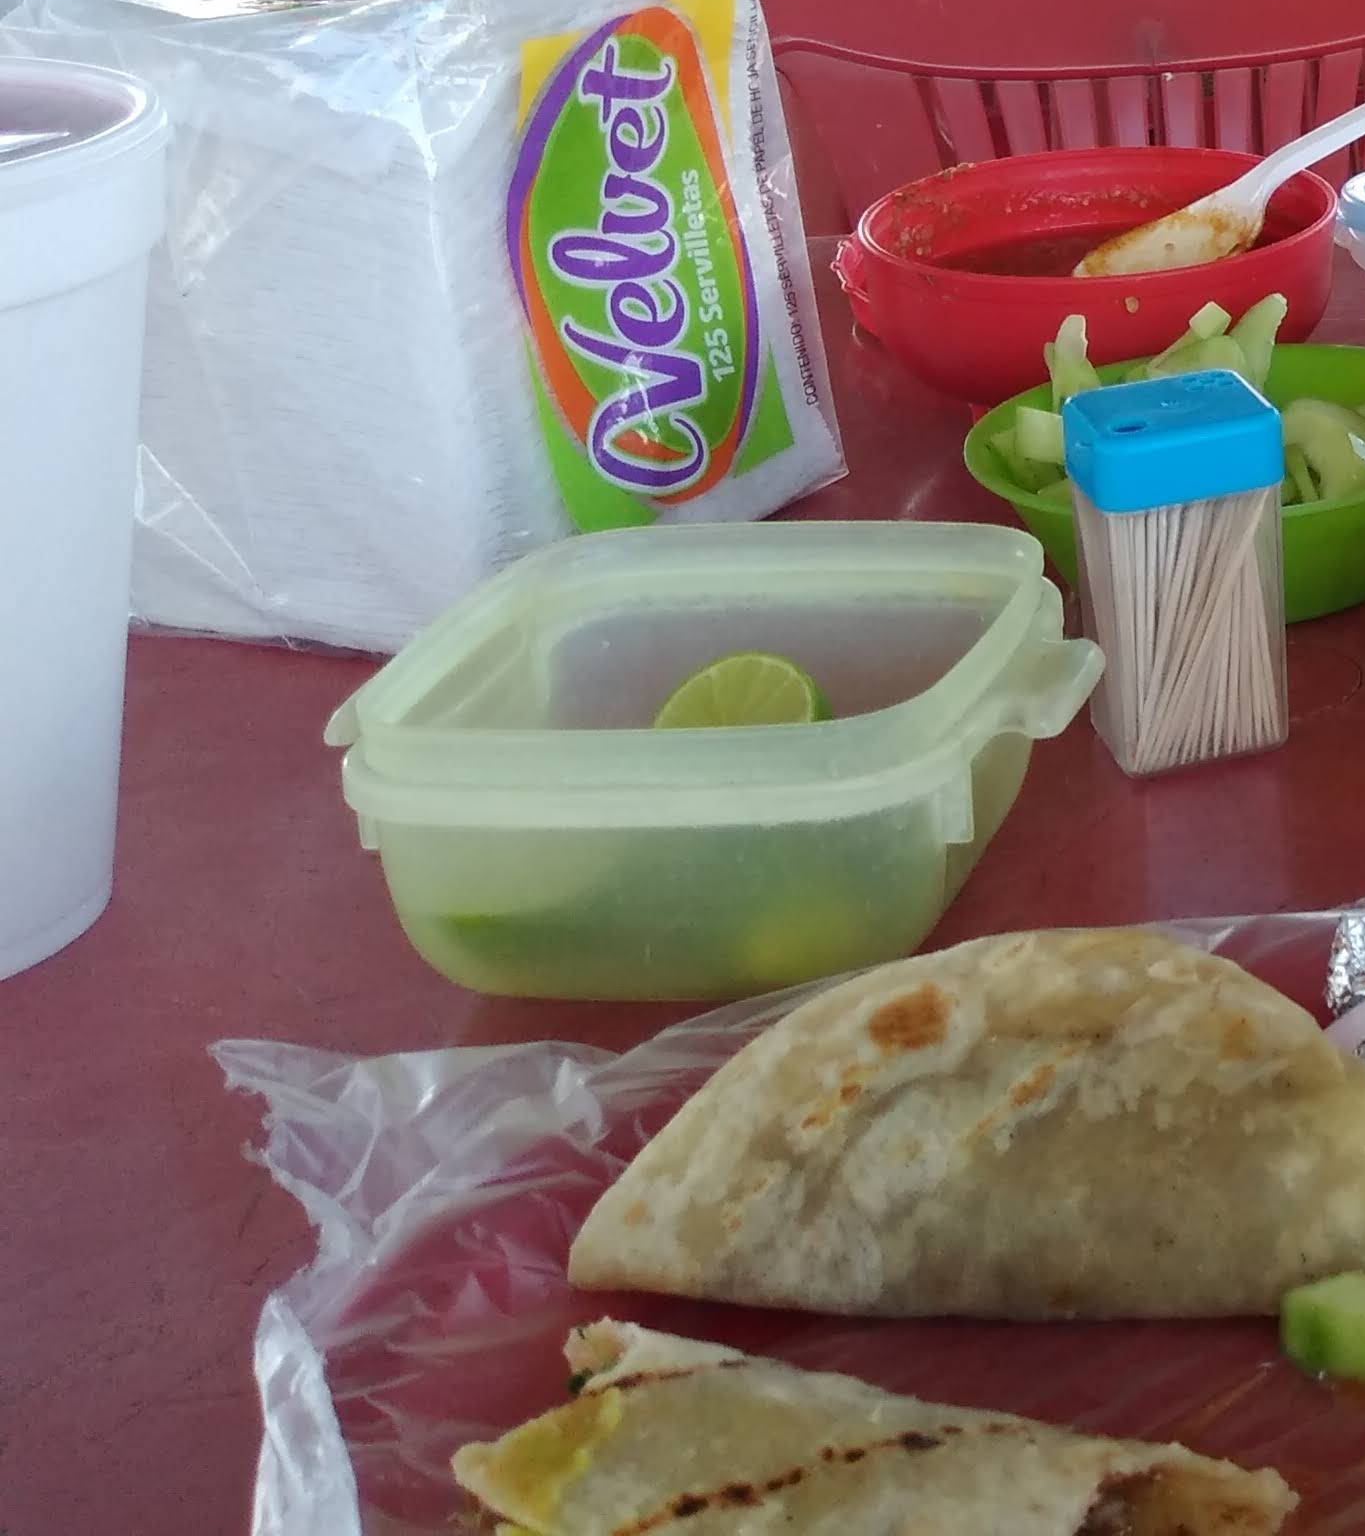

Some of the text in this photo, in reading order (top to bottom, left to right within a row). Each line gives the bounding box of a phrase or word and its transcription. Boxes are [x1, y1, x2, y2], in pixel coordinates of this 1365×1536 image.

[751, 104, 764, 125] DE
[753, 127, 766, 172] PAPEL
[550, 41, 707, 490] Velvet
[680, 167, 737, 384] 125 Servilletas
[761, 196, 794, 290] SERVILLETAS
[783, 291, 799, 317] 125
[790, 320, 819, 406] CONTENIDO:
